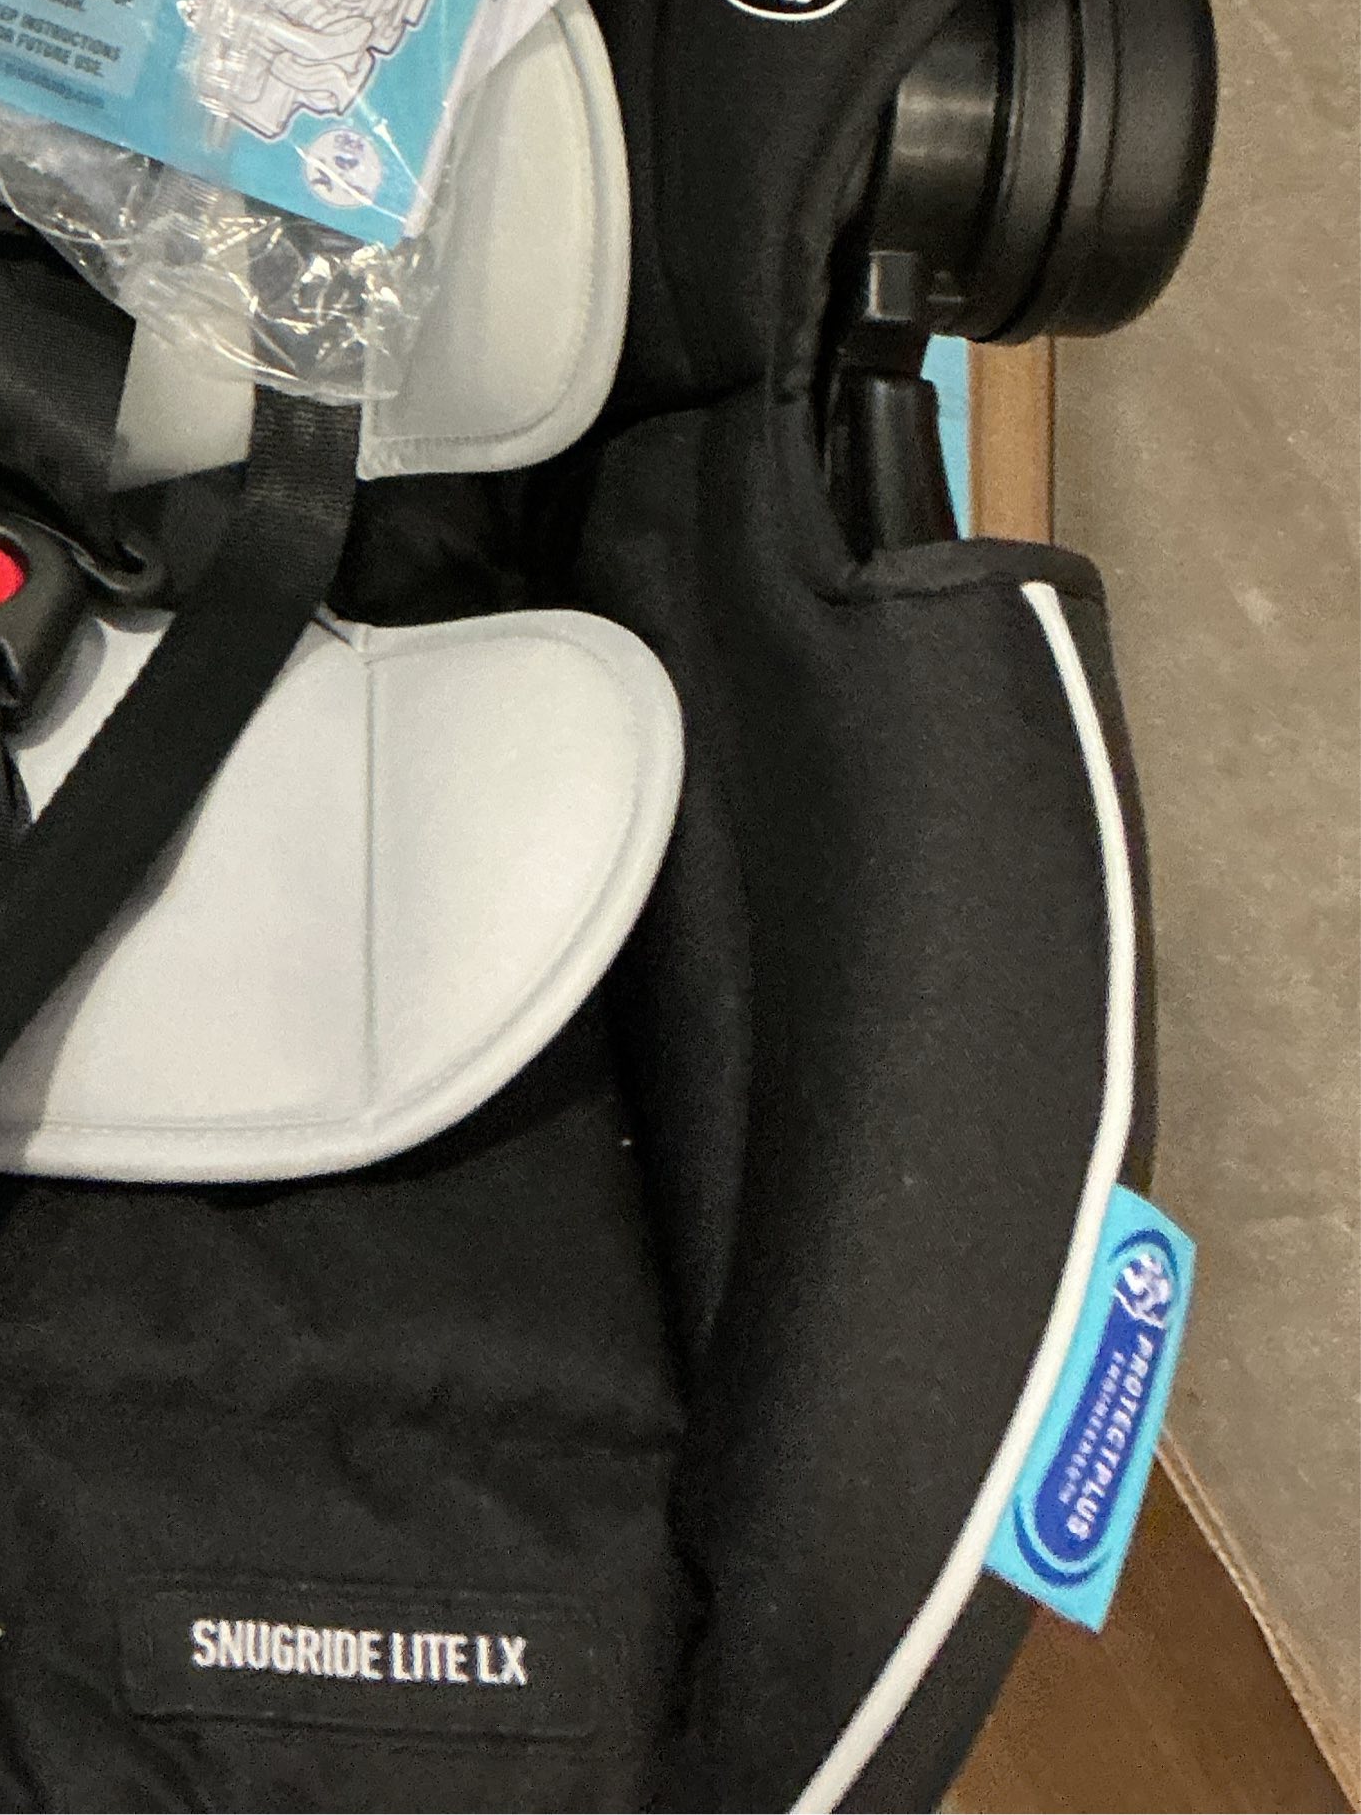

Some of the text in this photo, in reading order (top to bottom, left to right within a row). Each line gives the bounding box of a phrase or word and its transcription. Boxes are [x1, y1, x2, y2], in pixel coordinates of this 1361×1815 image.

[1066, 1333, 1154, 1542] PROTECTPLUS
[192, 1619, 528, 1685] SNUGRIDE LITE LX
